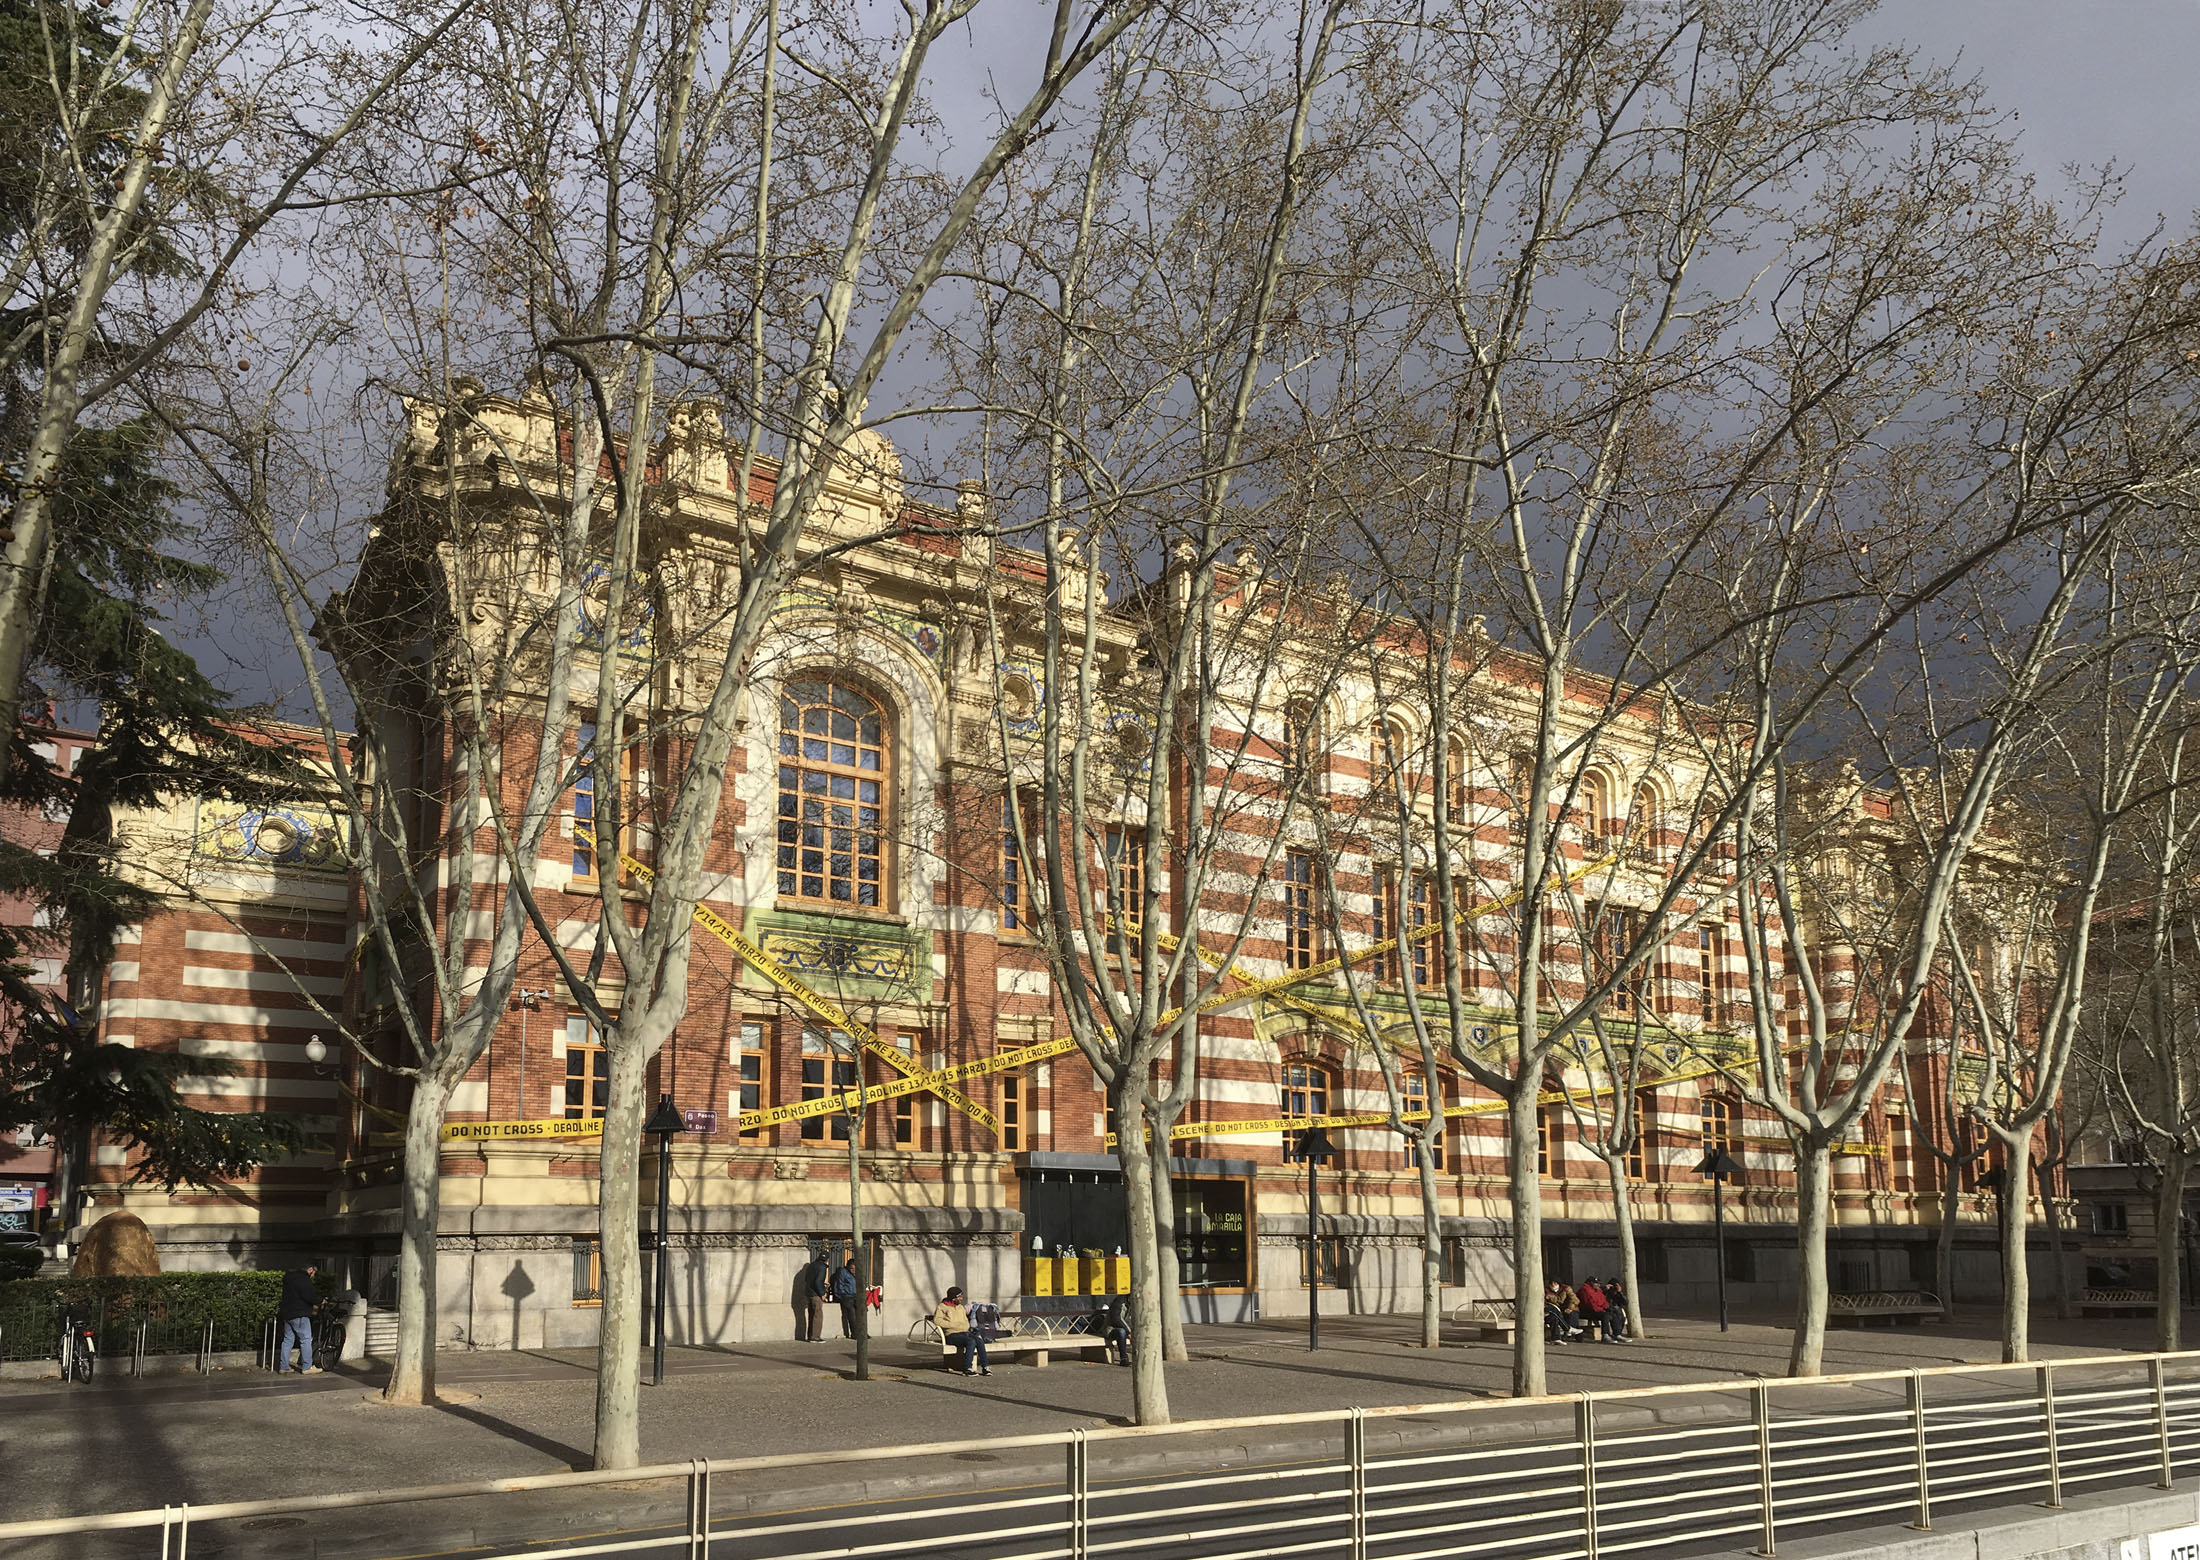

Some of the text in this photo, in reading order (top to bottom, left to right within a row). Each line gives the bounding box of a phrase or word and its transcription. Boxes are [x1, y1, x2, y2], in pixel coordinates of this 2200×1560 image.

[732, 936, 766, 965] MARZO
[771, 967, 787, 981] DO
[786, 978, 807, 997] NOT
[806, 993, 838, 1018] CROSS
[935, 1084, 963, 1105] ARZO
[966, 1104, 981, 1117] DO
[772, 1109, 787, 1121] DO
[790, 1105, 811, 1117] NOT
[814, 1097, 847, 1112] CROS
[908, 1071, 955, 1090] 13/14/15
[956, 1061, 987, 1077] MARZO
[994, 1058, 1006, 1068] DO
[1007, 1053, 1025, 1065] NOT
[1026, 1045, 1053, 1060] CROSS
[451, 1121, 600, 1137] DO NOT CROSS DEADLINE
[1179, 1125, 1209, 1136] SCENE
[1215, 1123, 1226, 1132] DO
[1228, 1122, 1243, 1131] NOT
[1245, 1121, 1269, 1130] CROSS
[1274, 1119, 1302, 1128] DESIGN
[1225, 1212, 1242, 1222] CAJA
[1206, 1222, 1243, 1232] AMARILLA
